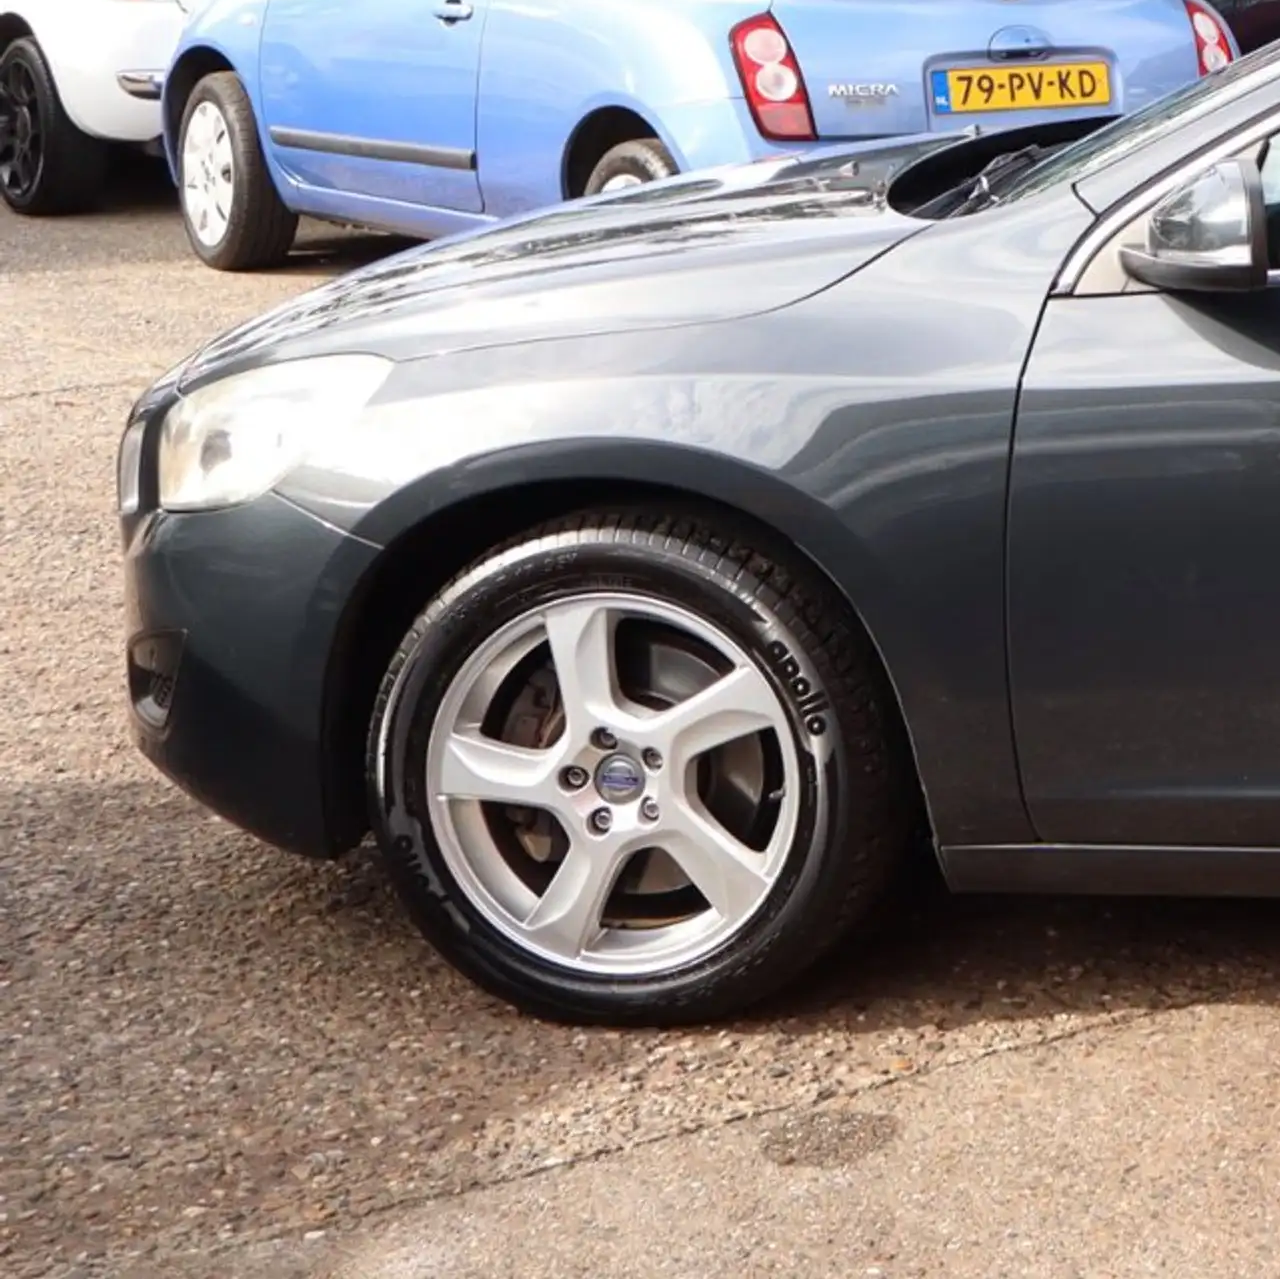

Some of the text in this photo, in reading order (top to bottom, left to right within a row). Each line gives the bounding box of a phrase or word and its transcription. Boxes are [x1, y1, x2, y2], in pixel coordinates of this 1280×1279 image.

[828, 84, 899, 96] MICRA
[956, 70, 1097, 106] 79-PV-KD
[767, 640, 827, 736] apollo
